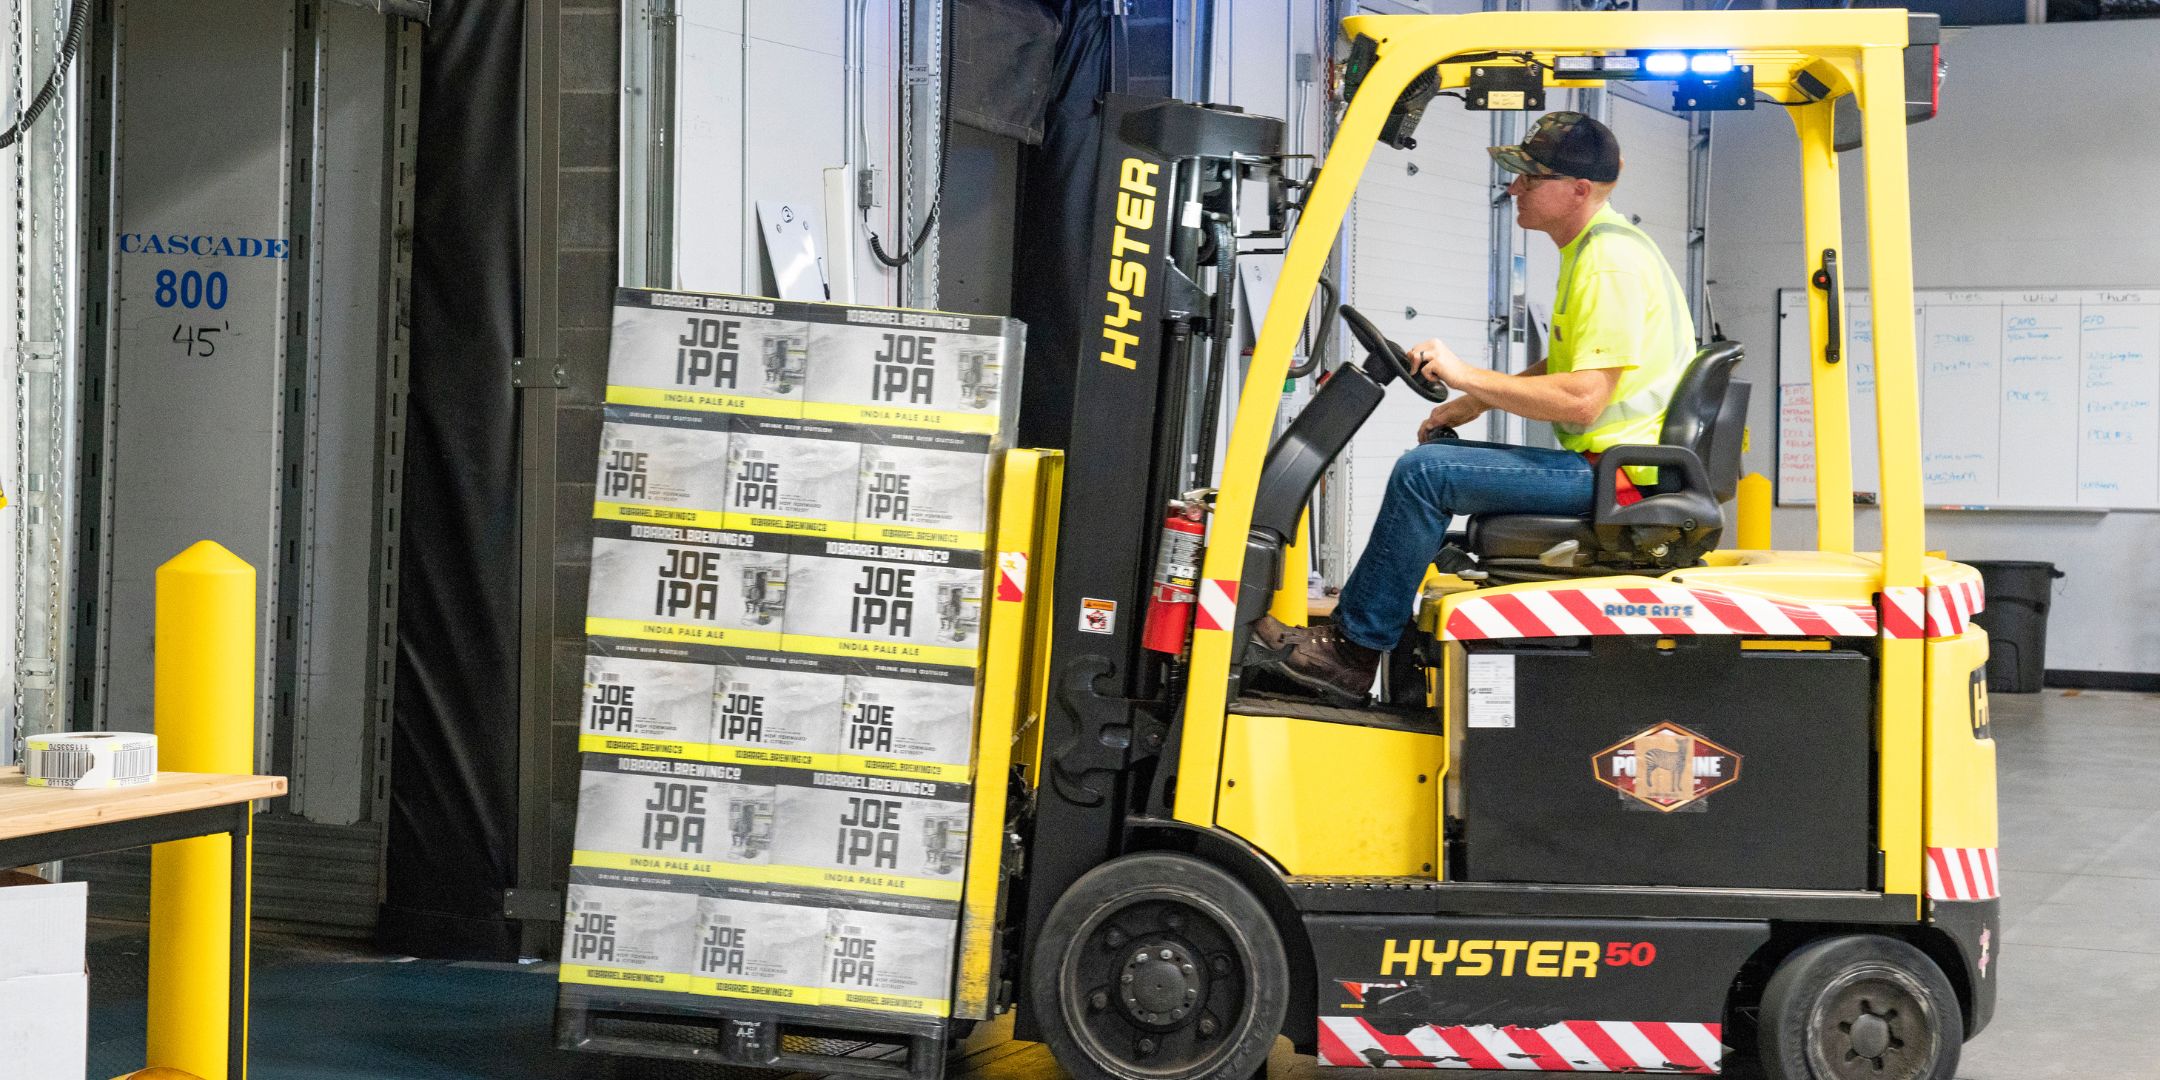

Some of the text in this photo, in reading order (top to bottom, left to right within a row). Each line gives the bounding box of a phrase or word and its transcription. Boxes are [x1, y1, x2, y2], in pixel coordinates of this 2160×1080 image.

[120, 233, 289, 258] CASCADE
[1100, 158, 1159, 370] HYSTER
[155, 269, 228, 310] 800
[680, 318, 741, 350] JOE
[875, 334, 936, 366] JOE
[676, 349, 738, 389] IPA
[872, 364, 934, 404] IPA
[664, 394, 694, 403] INDIA
[700, 397, 723, 406] PALE
[860, 411, 890, 419] INDIA
[895, 413, 918, 421] PALE
[606, 451, 648, 472] JOE
[738, 461, 779, 483] JOE
[604, 472, 646, 498] IPA
[735, 482, 777, 509] IPA
[870, 473, 910, 495] JOE
[867, 494, 908, 520] IPA
[659, 549, 720, 581] JOE
[855, 566, 915, 598] JOE
[656, 580, 718, 620] IPA
[1604, 604, 1694, 616] RIDE RITE
[850, 597, 912, 637] IPA
[644, 625, 724, 639] INDIA PALE ALE
[839, 643, 919, 656] INDIA PALE ALE
[593, 684, 634, 706] JOE
[723, 694, 764, 716] JOE
[590, 705, 632, 732] IPA
[720, 715, 762, 742] IPA
[852, 704, 894, 726] JOE
[850, 725, 892, 752] IPA
[646, 782, 708, 814] JOE
[841, 797, 902, 830] JOE
[642, 813, 705, 853] IPA
[836, 828, 898, 869] IPA
[630, 859, 711, 872] INDIA PALE ALE
[824, 873, 905, 888] INDIA PALE ALE
[575, 913, 616, 935] JOE
[704, 926, 746, 948] JOE
[571, 933, 615, 961] IPA
[701, 947, 744, 974] IPA
[834, 937, 876, 959] JOE
[1380, 939, 1656, 978] HYSTER 50
[831, 958, 874, 986] IPA
